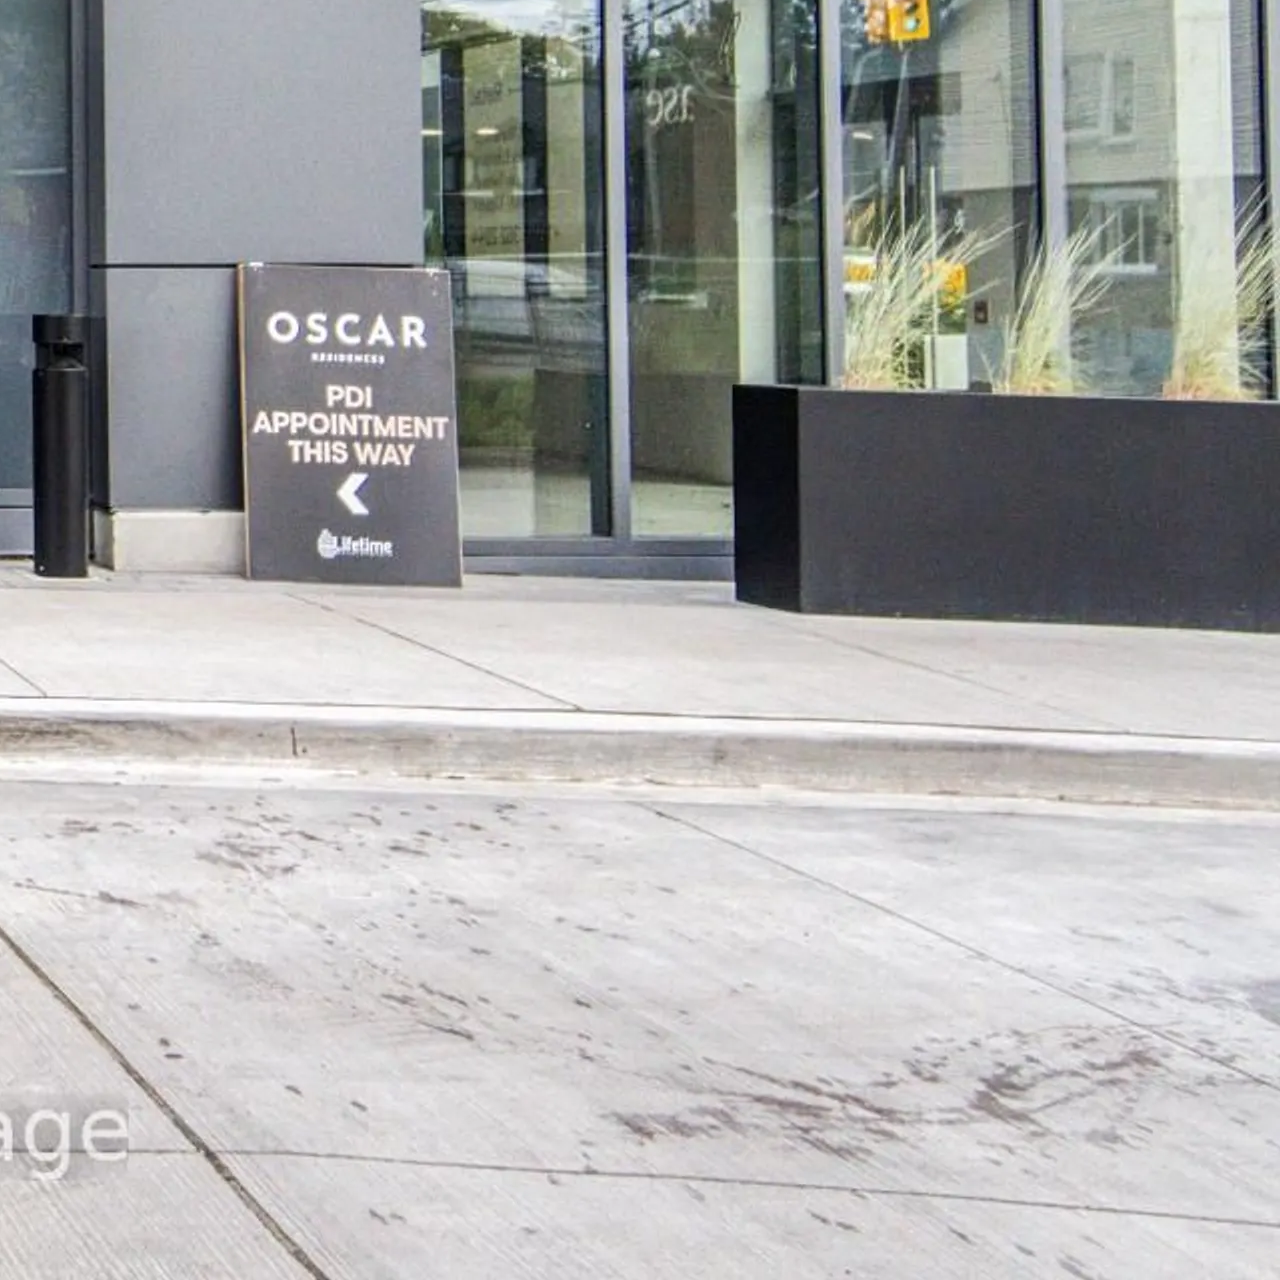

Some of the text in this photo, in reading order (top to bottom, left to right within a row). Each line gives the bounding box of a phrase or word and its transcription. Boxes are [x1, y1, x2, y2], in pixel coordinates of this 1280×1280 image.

[267, 311, 427, 348] OSCAR
[326, 385, 372, 408] PDI
[253, 411, 449, 439] APPOINTMENT
[288, 439, 415, 466] THIS WAY
[331, 535, 393, 554] Lifetime
